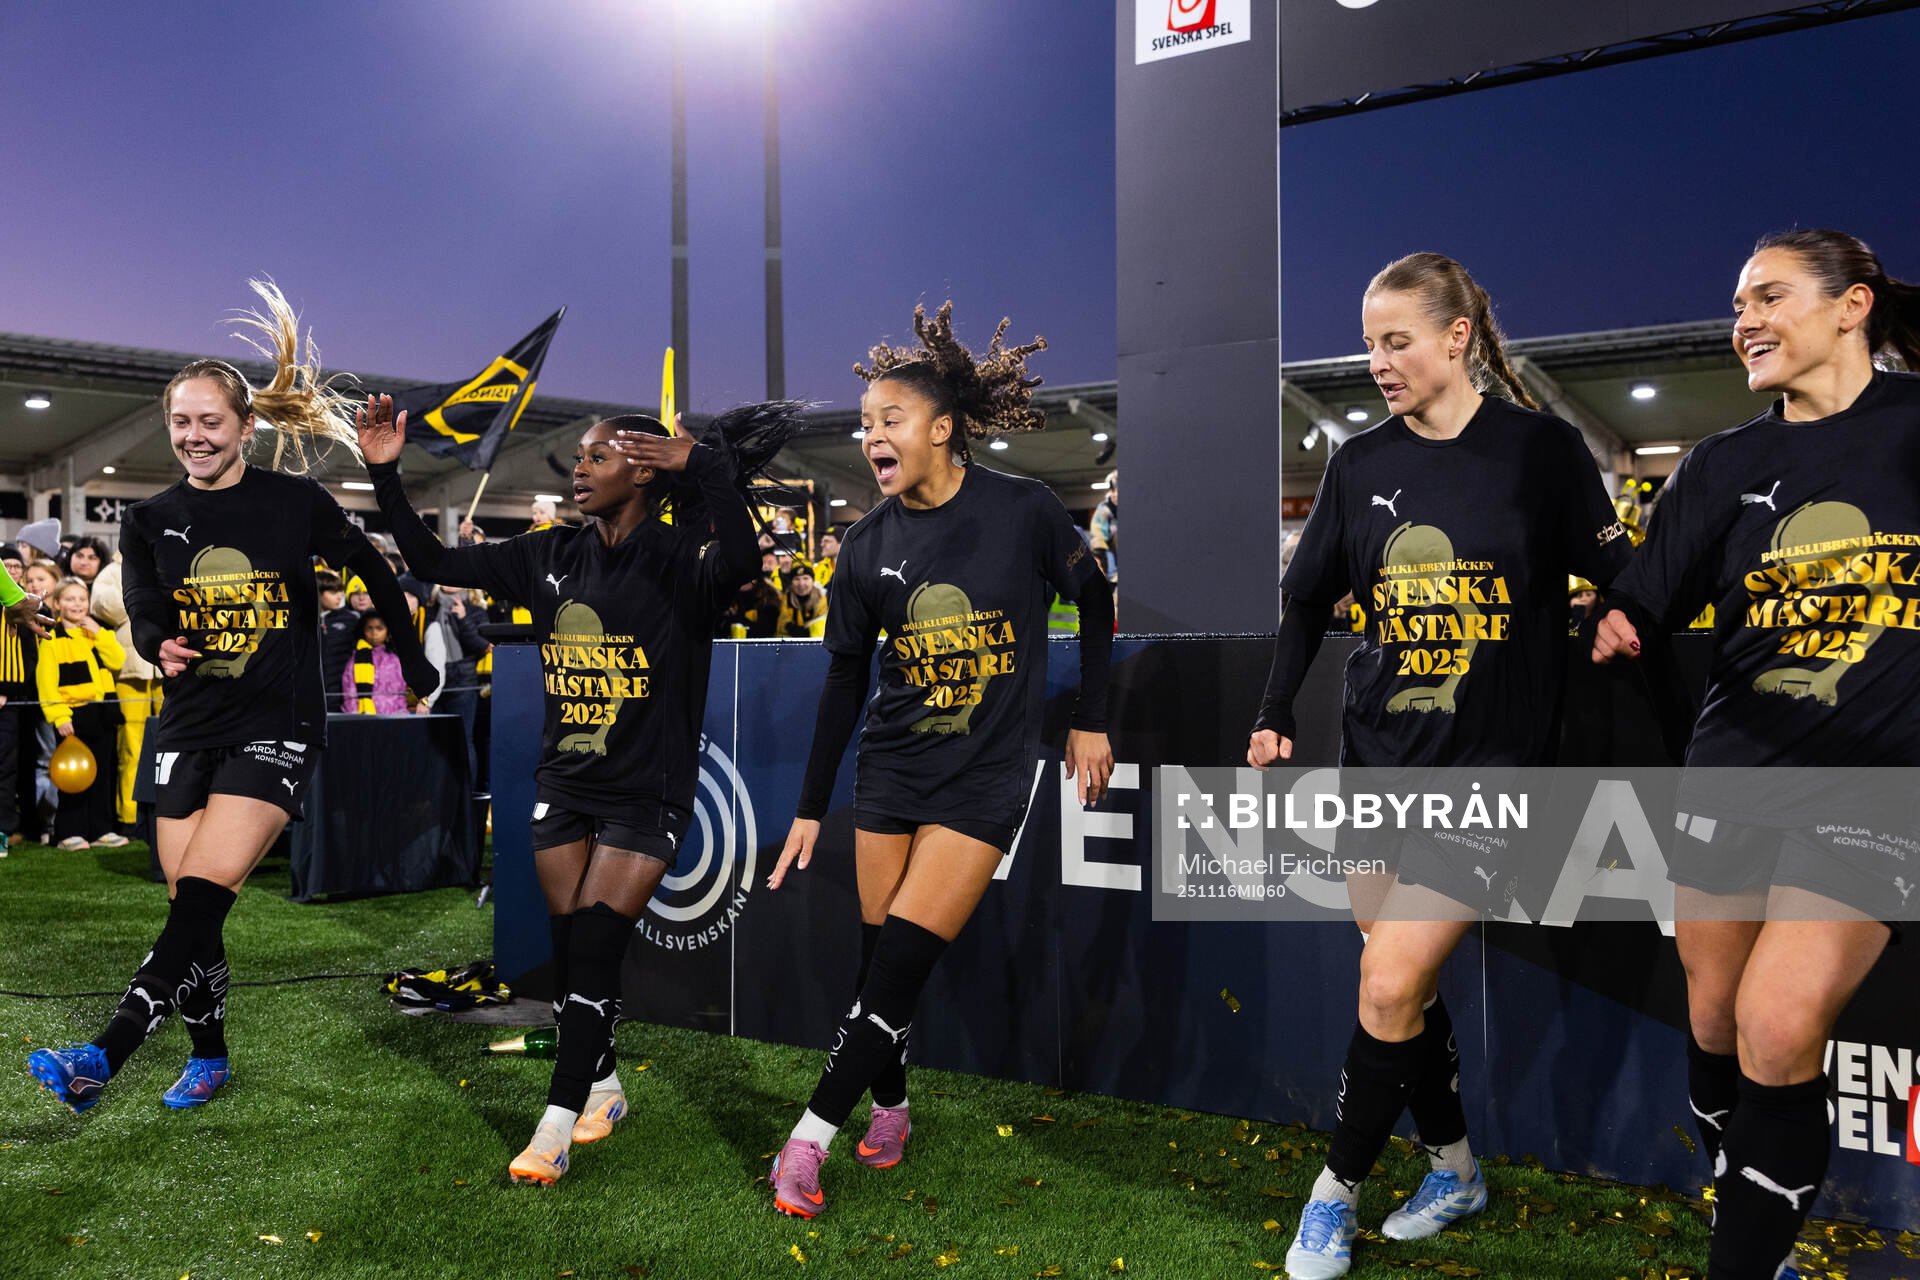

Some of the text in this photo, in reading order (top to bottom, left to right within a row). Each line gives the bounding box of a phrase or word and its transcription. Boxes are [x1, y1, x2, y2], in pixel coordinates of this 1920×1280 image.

[1152, 22, 1233, 51] SVENSKA SPEL
[1761, 537, 1861, 563] BOLLKLUBBEN
[183, 570, 281, 585] BOLLKLUBBEN HÄCKEN
[1447, 559, 1494, 571] HÄCKEN
[172, 582, 289, 606] SVENSKA
[1372, 575, 1512, 612] SVENSKA
[179, 607, 290, 630] MÄSTARE
[902, 608, 1004, 632] BOLLKLUBBEN HÄCKEN
[204, 631, 259, 654] 2025
[894, 619, 1016, 660] SVENSKA
[1777, 629, 1870, 663] 2025
[541, 643, 650, 670] SVENSKA
[898, 651, 1015, 687] MÄSTARE
[1397, 648, 1471, 676] 2025
[544, 667, 650, 698] MÄSTARE
[923, 683, 982, 709] 2025
[560, 701, 617, 726] 2025
[279, 750, 305, 765] JOHAN
